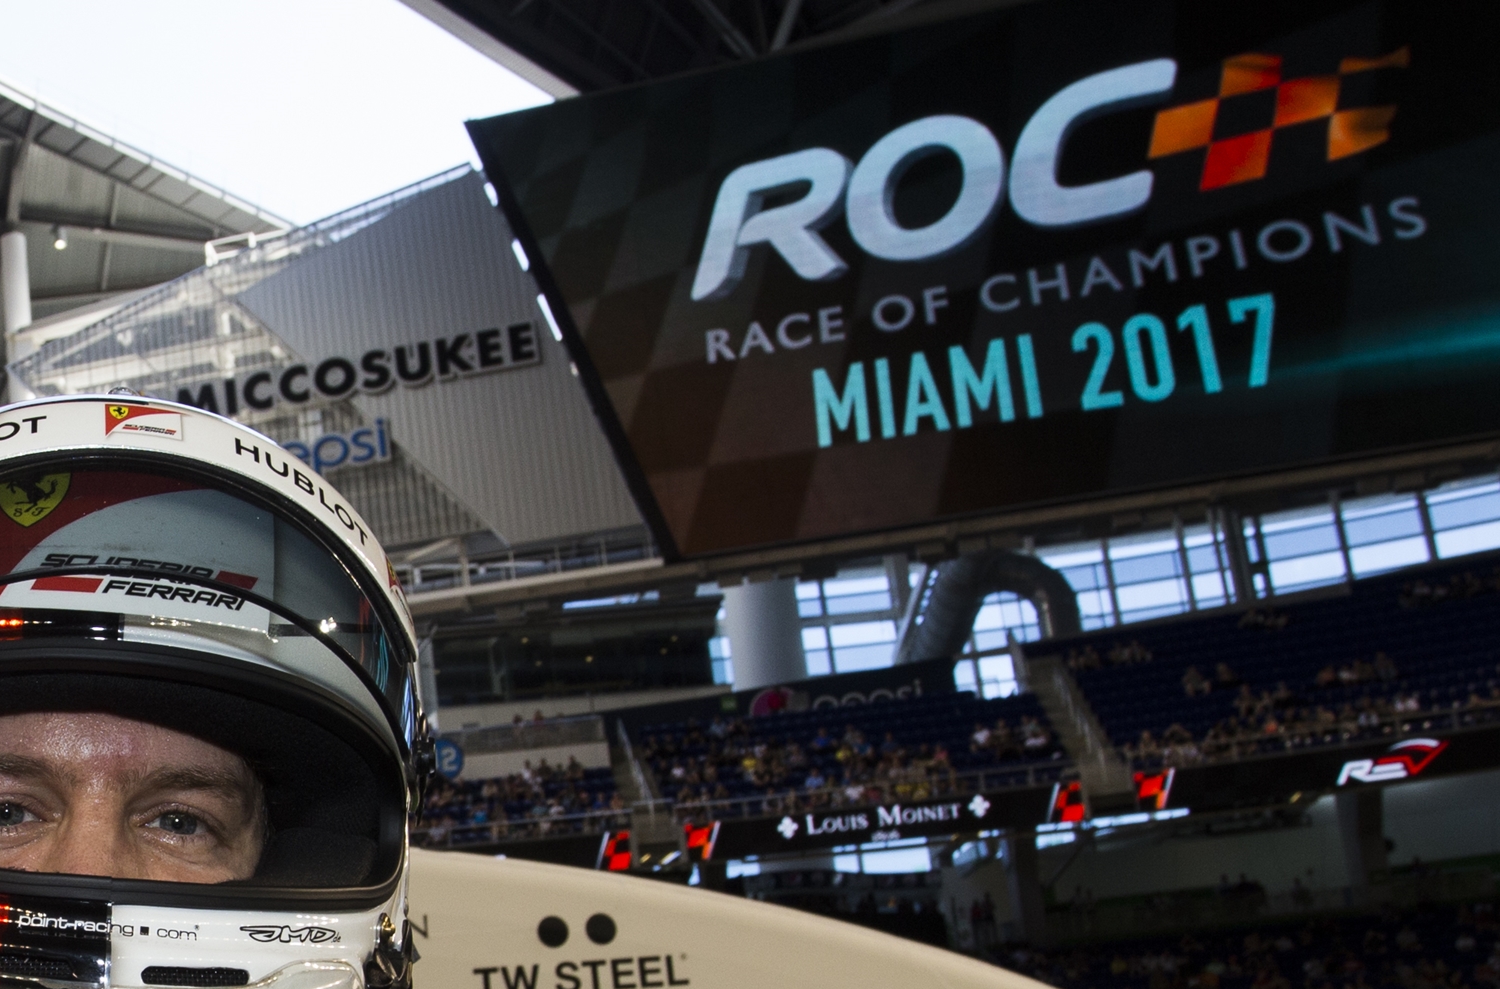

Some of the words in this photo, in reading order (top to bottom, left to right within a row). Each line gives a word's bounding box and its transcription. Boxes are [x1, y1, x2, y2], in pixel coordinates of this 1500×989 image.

[691, 57, 1178, 302] ROC
[705, 305, 846, 364] RACE
[871, 286, 950, 333] OF
[979, 197, 1428, 312] CHAMPIONS
[176, 321, 537, 417] MICCOSUKEE
[811, 332, 1044, 448] MIAMI
[1071, 292, 1276, 411] 2017
[234, 437, 368, 546] HUBLOT
[281, 417, 388, 475] epsi
[101, 578, 245, 612] FERRARI
